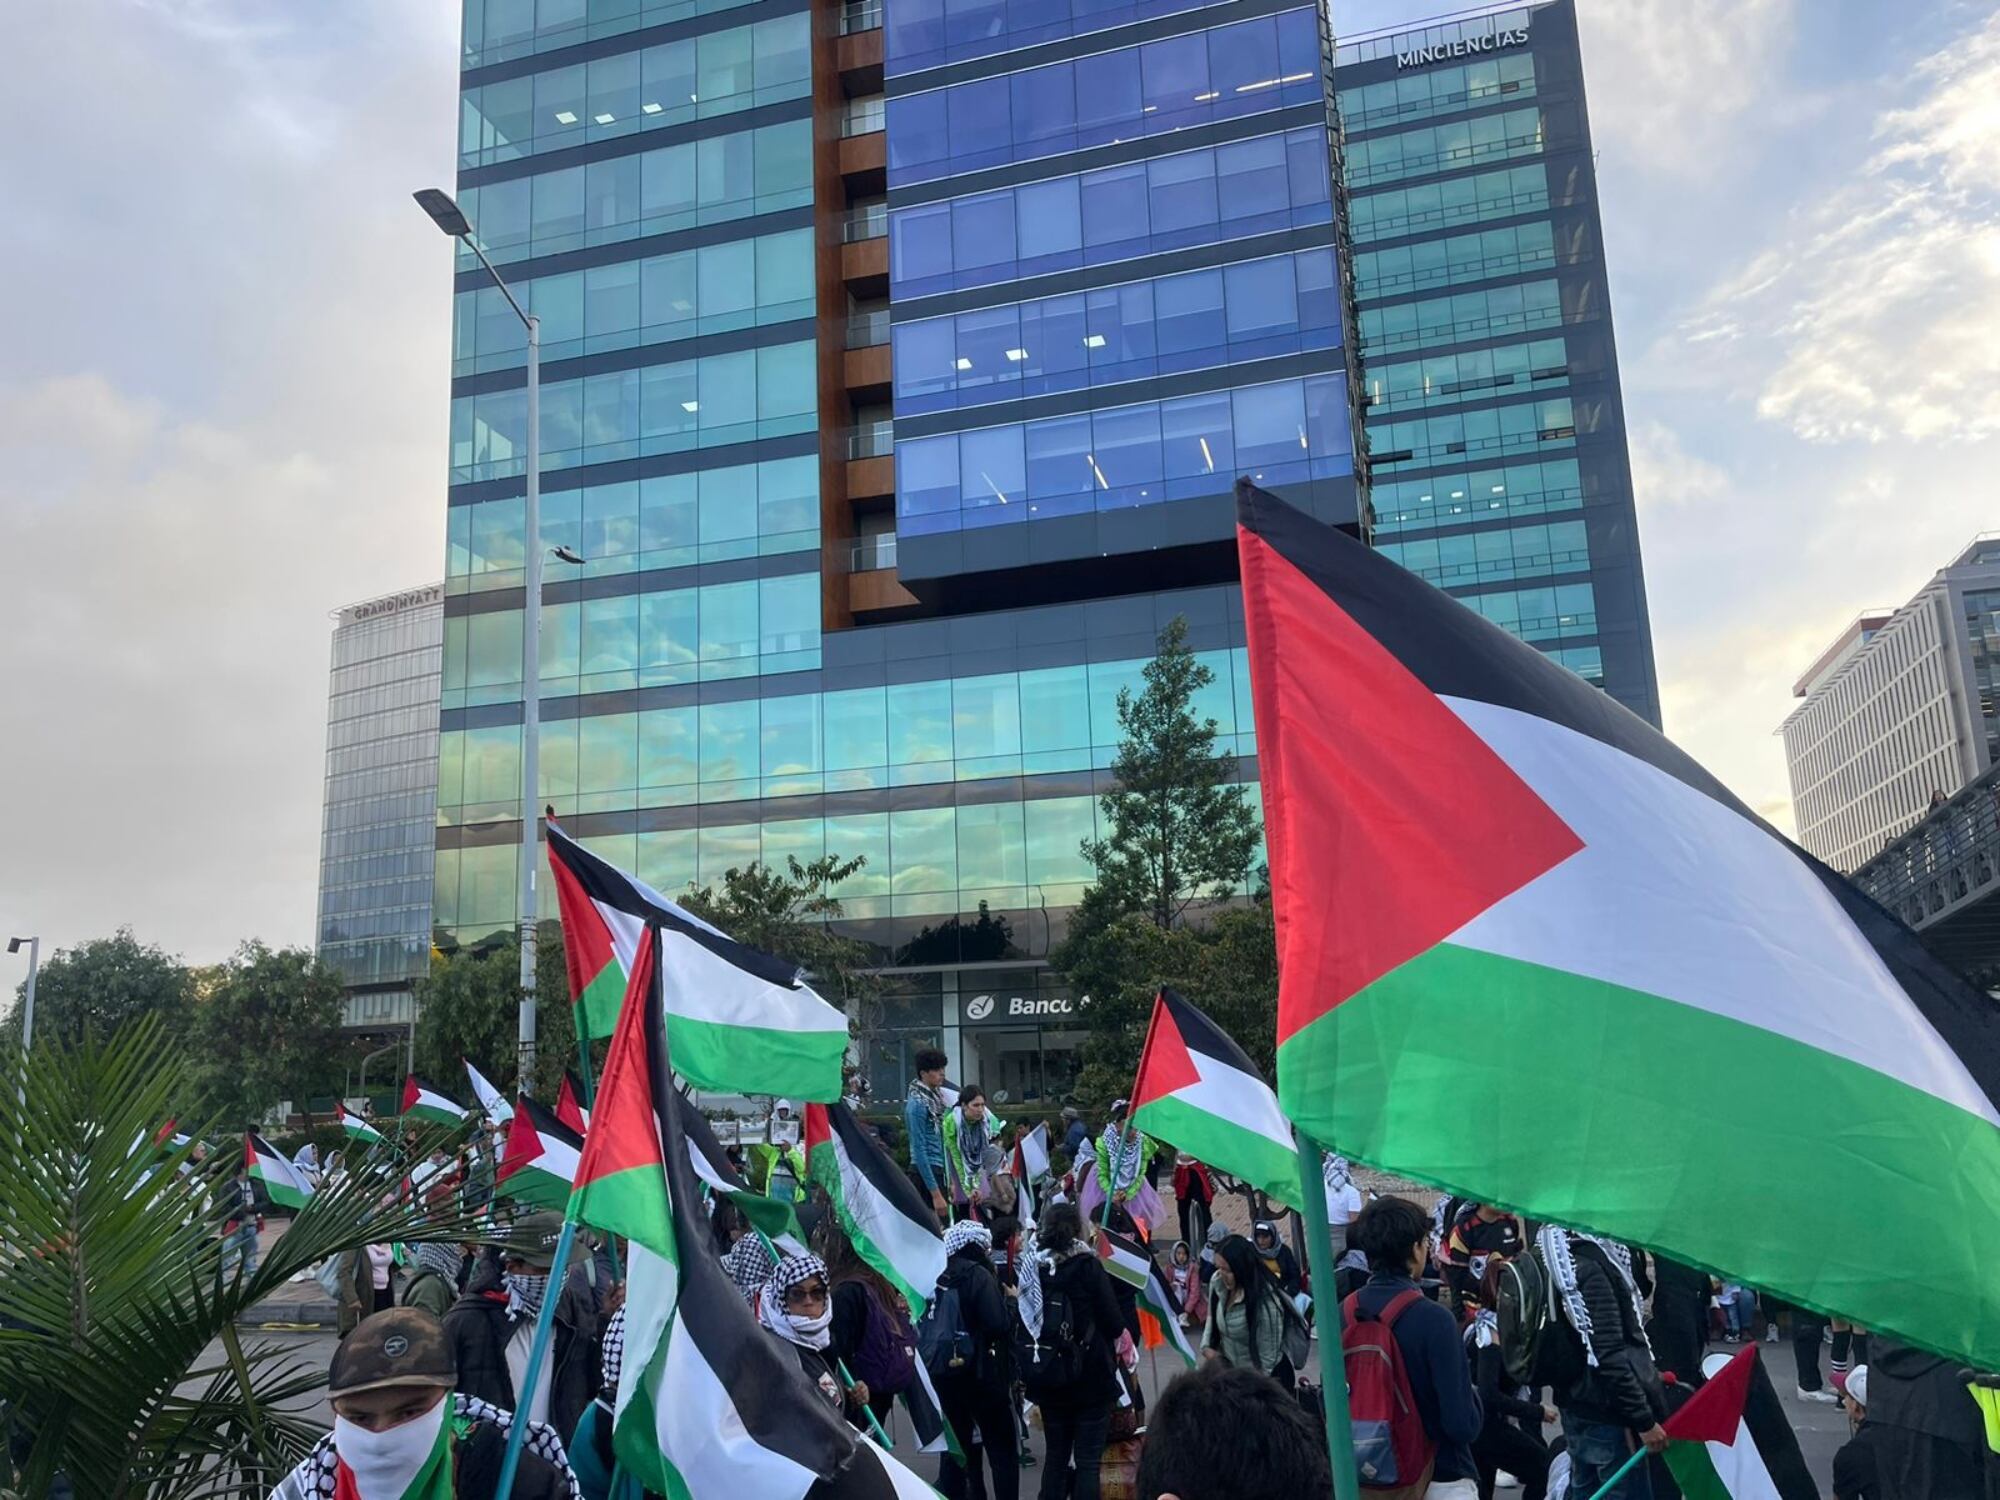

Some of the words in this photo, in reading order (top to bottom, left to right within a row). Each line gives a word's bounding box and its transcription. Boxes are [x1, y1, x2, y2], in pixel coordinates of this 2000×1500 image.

[1397, 29, 1528, 68] MINCIENCIAS
[355, 600, 395, 619] GRAND
[400, 589, 439, 608] HYATT
